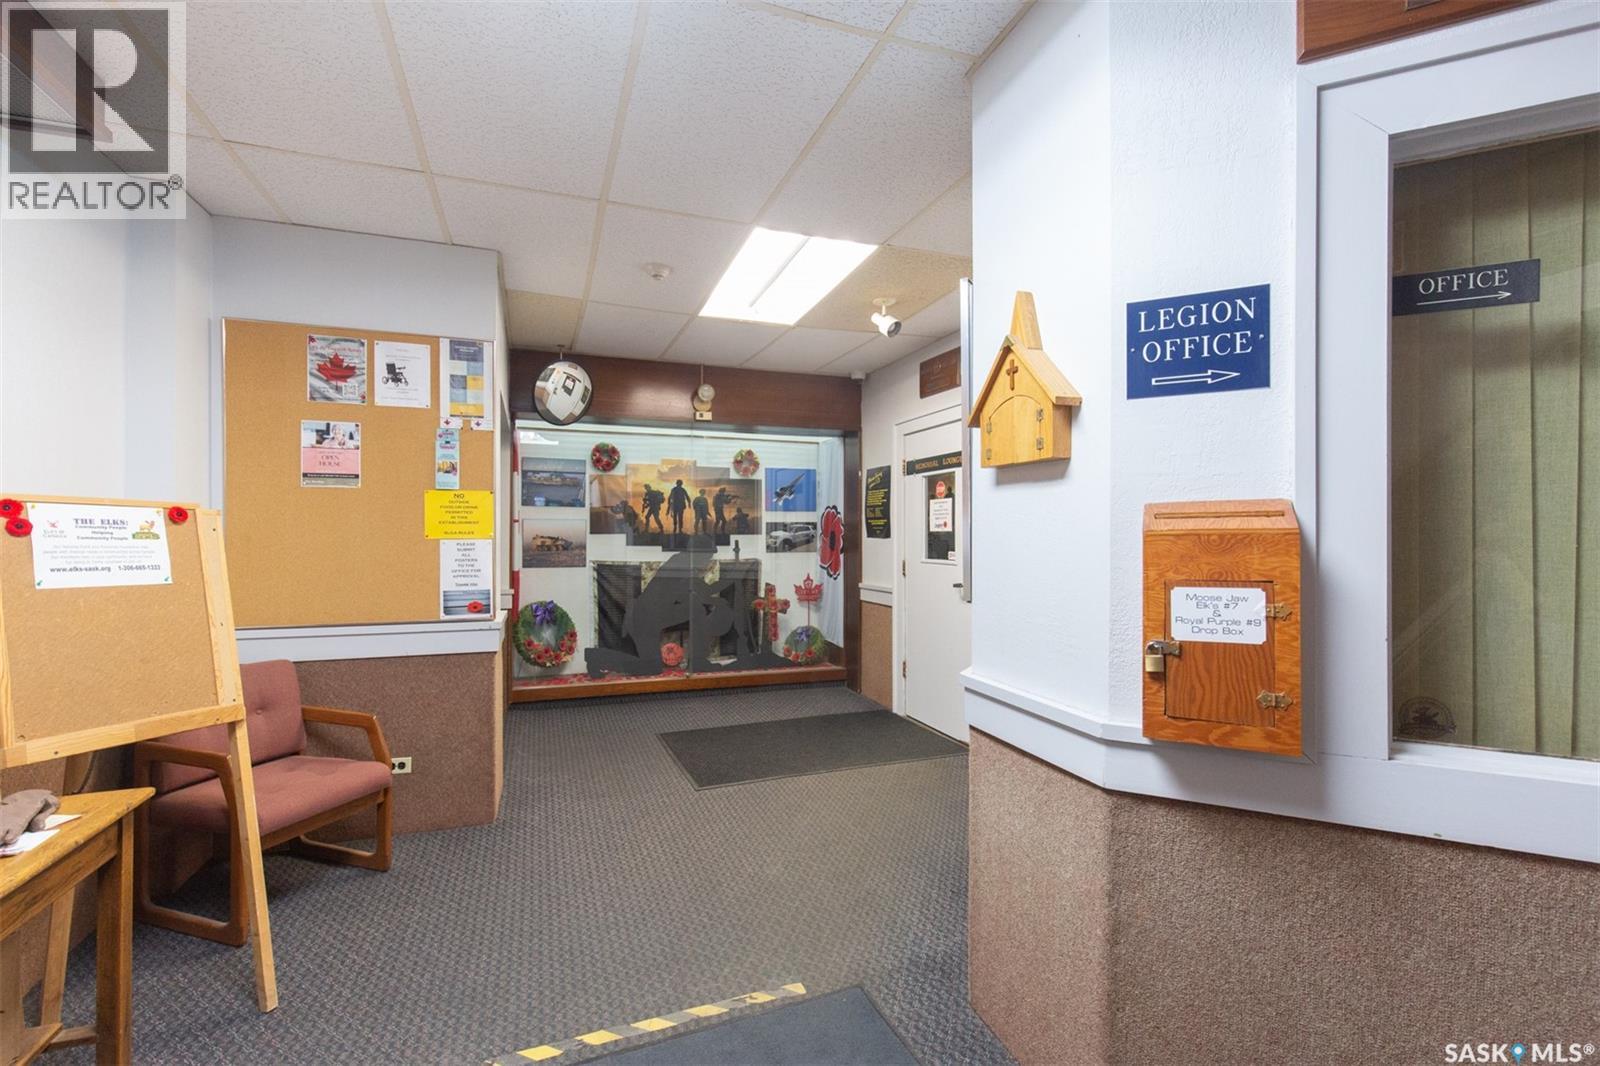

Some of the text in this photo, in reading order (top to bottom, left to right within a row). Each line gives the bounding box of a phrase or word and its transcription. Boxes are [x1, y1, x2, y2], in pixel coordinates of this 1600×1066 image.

[1418, 268, 1510, 295] OFFICE
[1138, 296, 1257, 333] LEGION
[1142, 330, 1254, 363] OFFICE
[100, 518, 129, 526] ELKS:
[1185, 593, 1249, 603] Moose Jaw
[1223, 602, 1238, 610] #7
[1175, 616, 1262, 628] Royal Purple #9
[1191, 626, 1245, 636] Drop Box
